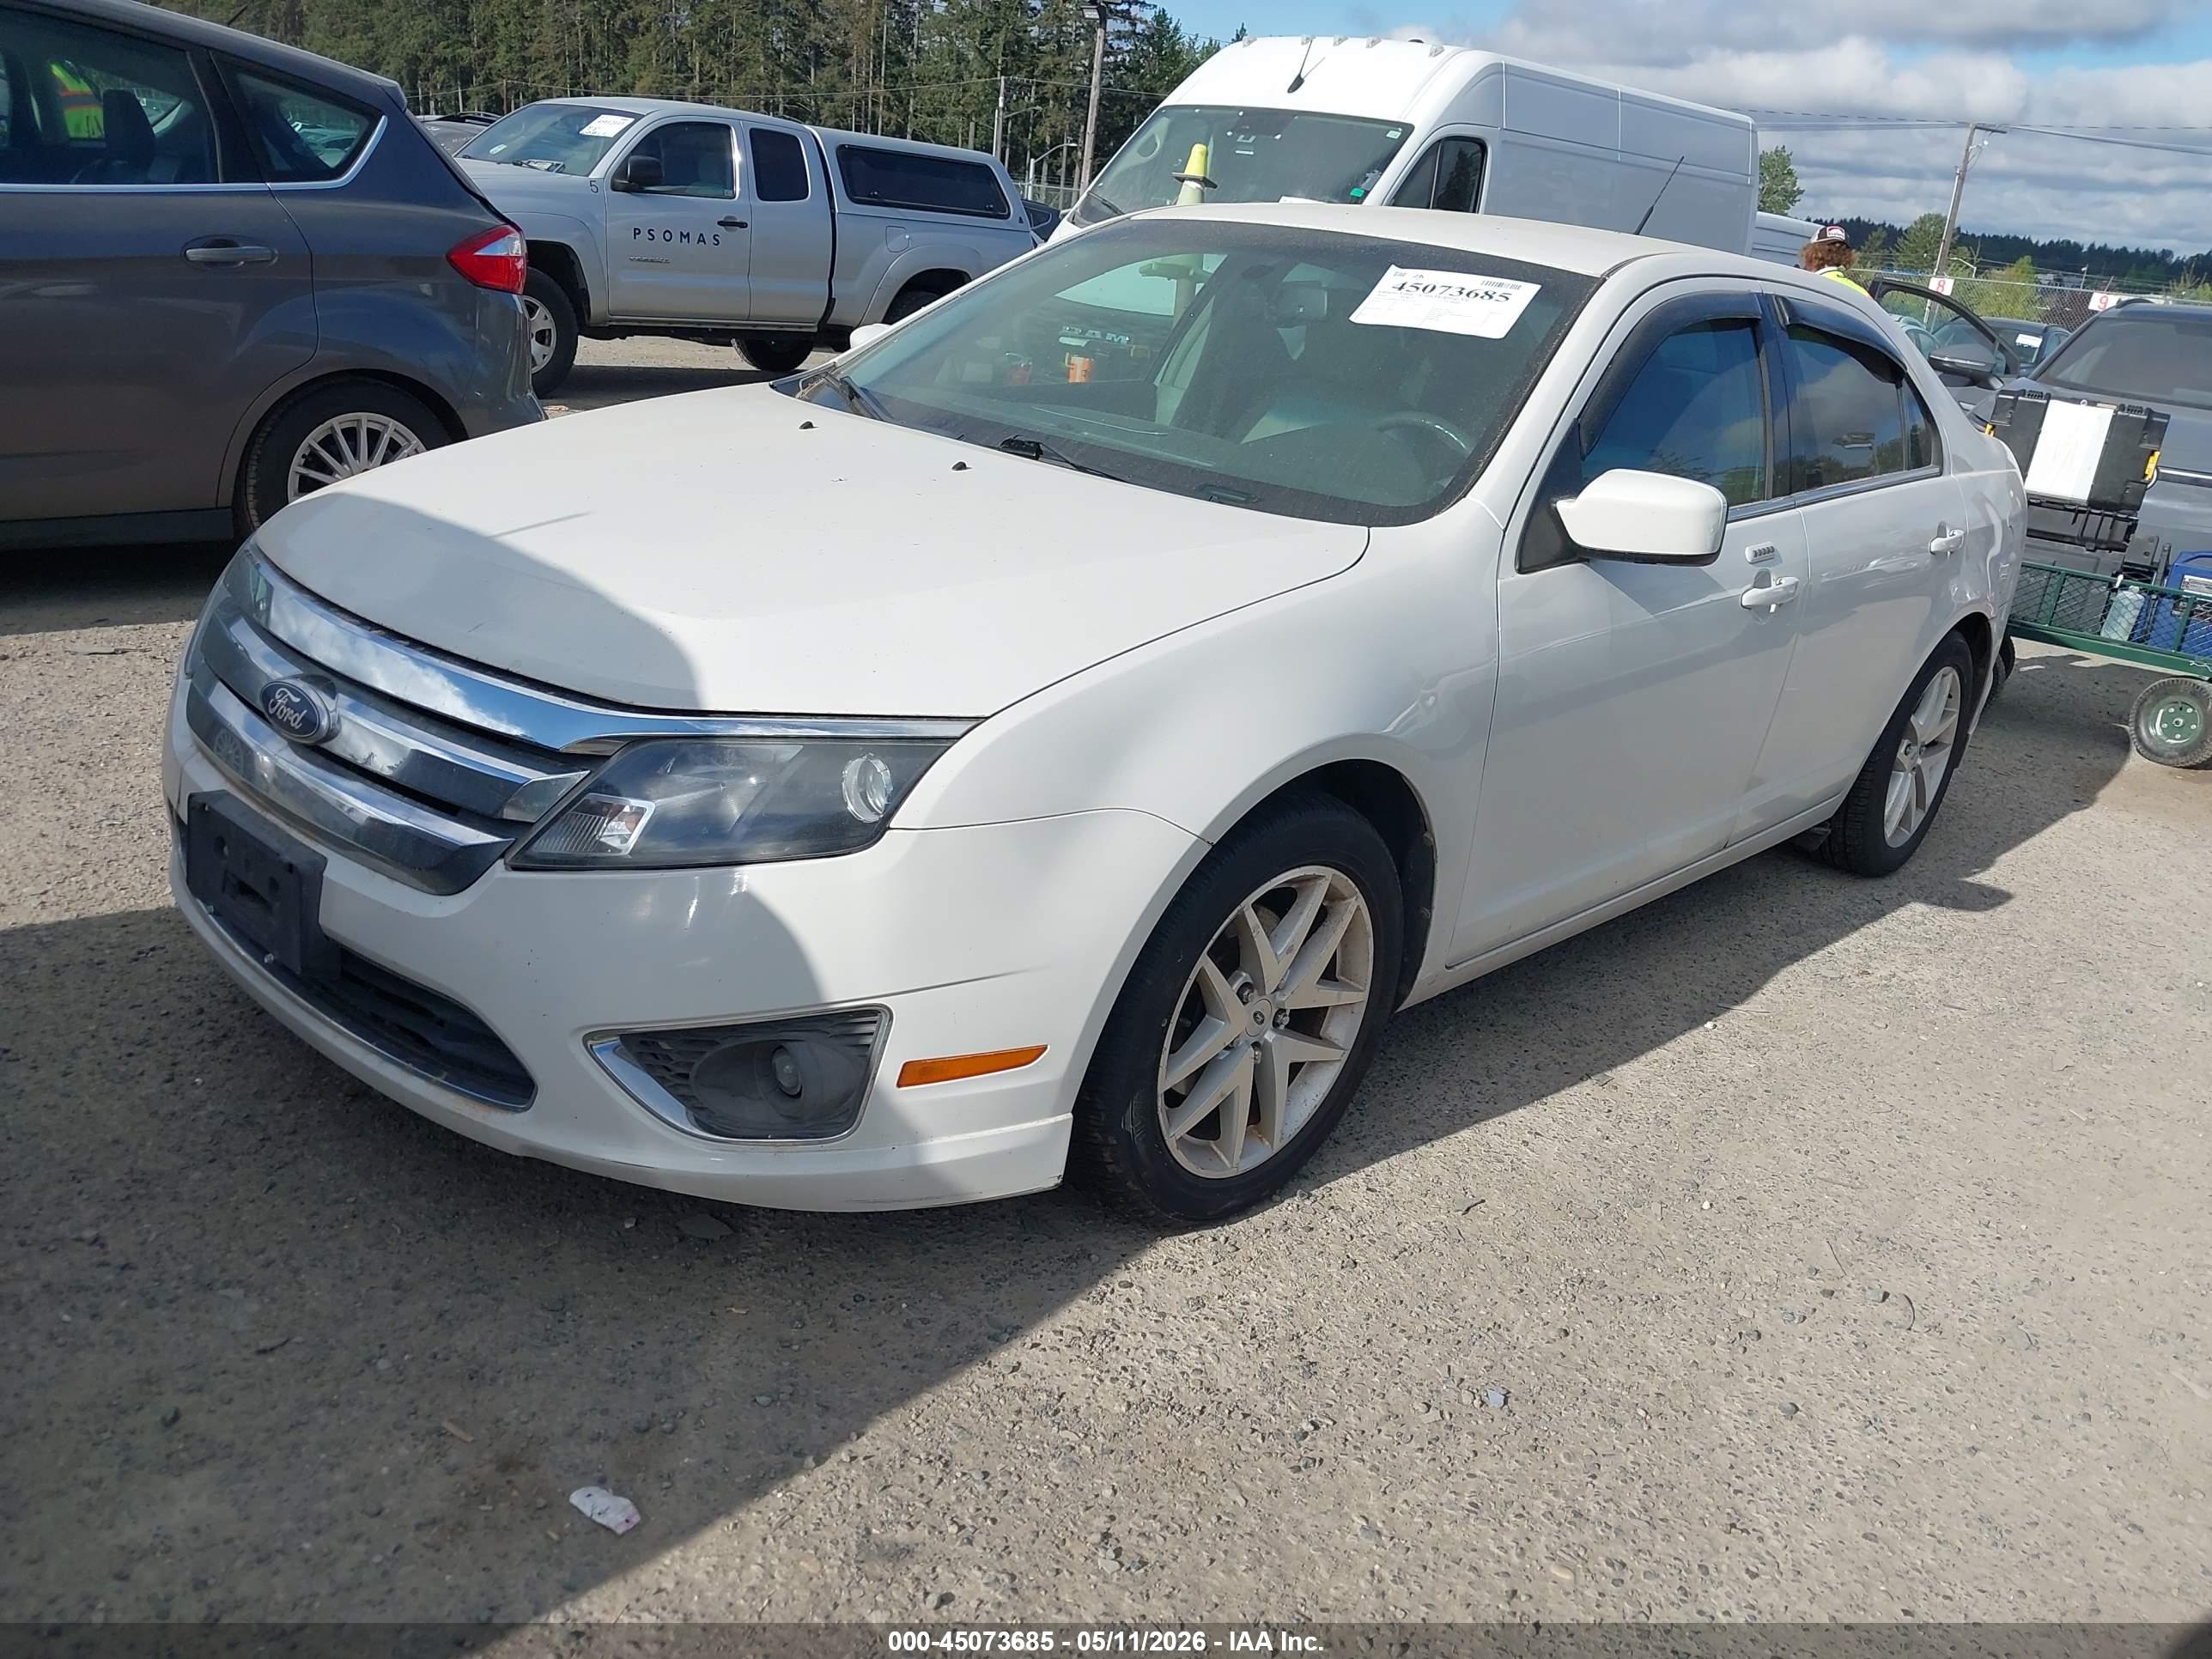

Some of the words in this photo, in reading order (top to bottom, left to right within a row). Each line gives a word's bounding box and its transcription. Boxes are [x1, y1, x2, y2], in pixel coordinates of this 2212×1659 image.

[590, 180, 599, 193] 5
[634, 228, 720, 246] PSOMAS
[1392, 281, 1511, 302] 45073685
[1936, 279, 1946, 293] 8
[2097, 295, 2109, 310] 9
[269, 689, 307, 729] Ford
